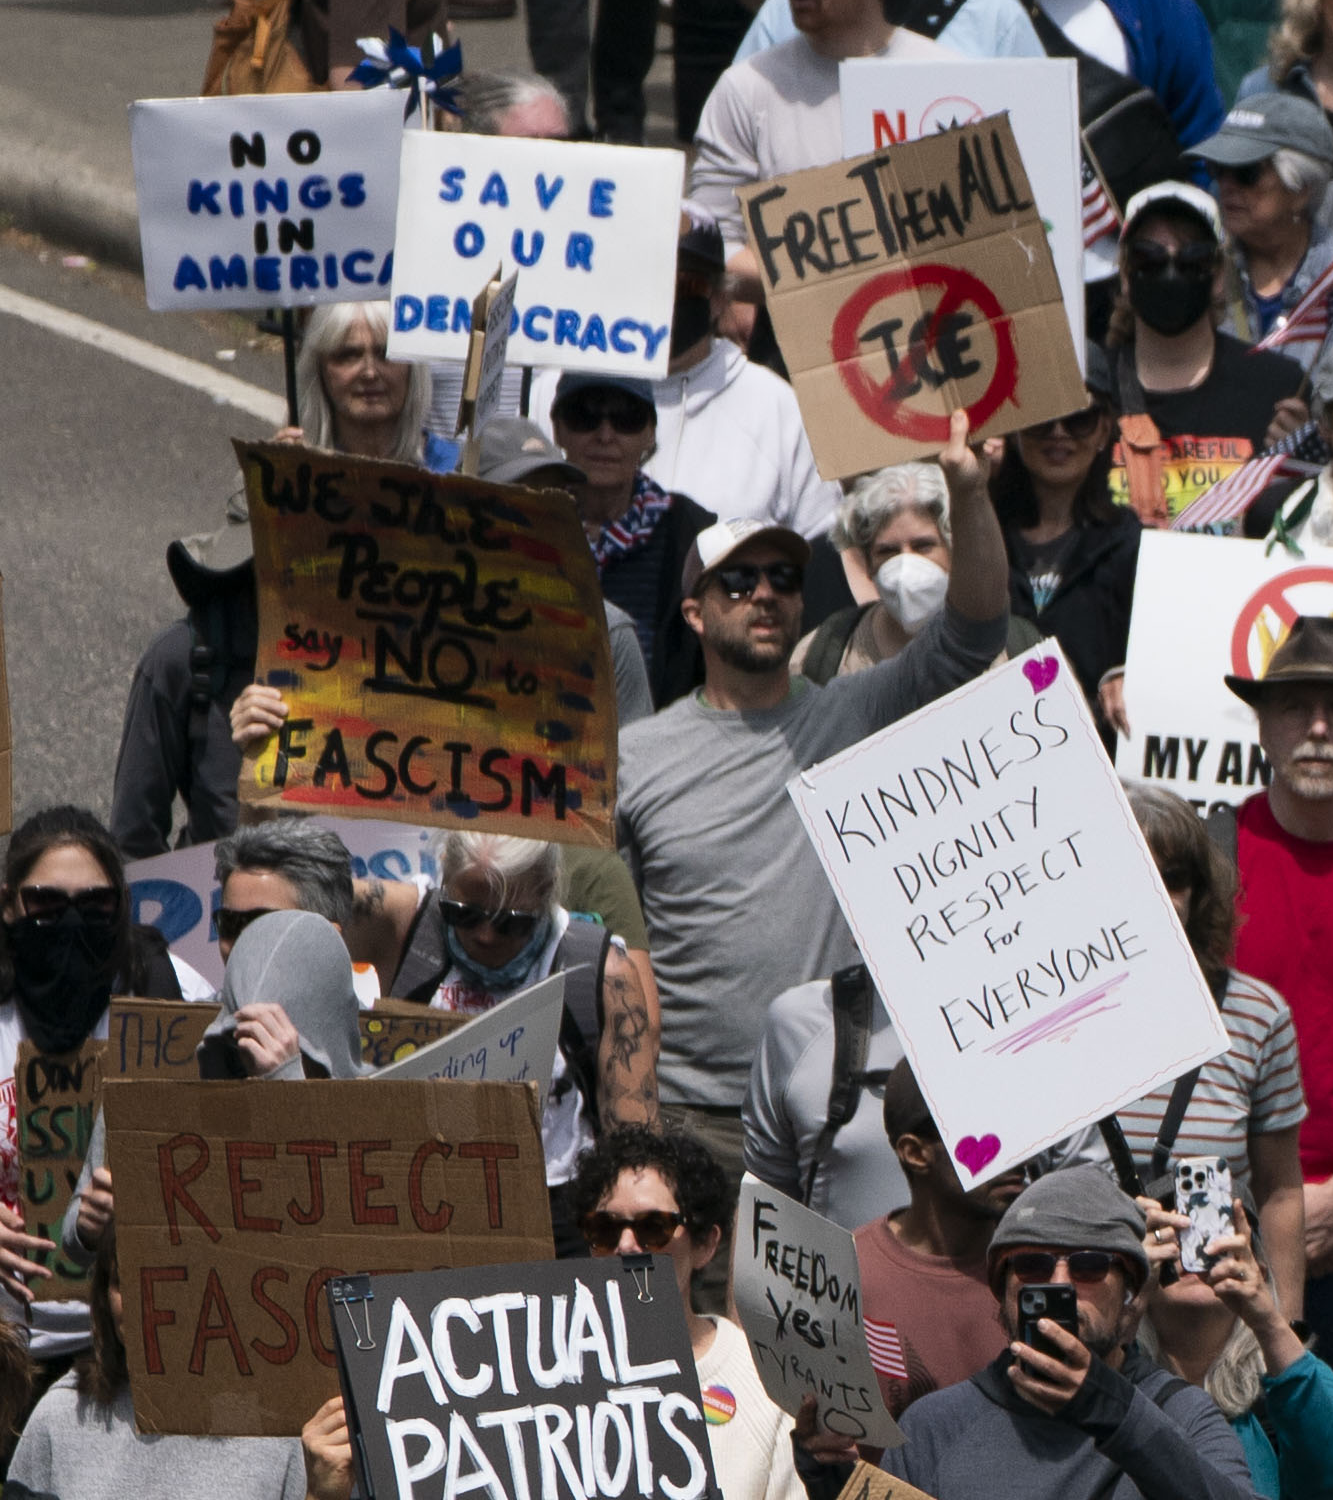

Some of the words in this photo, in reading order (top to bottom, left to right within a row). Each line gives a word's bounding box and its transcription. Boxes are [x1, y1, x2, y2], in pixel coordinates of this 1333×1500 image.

[230, 129, 322, 170] NO
[187, 172, 366, 219] KINGS
[438, 167, 618, 219] SAVE
[255, 217, 315, 255] IN
[453, 221, 596, 274] OUR
[284, 623, 344, 671] say
[364, 627, 478, 696] NO
[504, 655, 541, 696] to
[156, 1131, 520, 1248] REJECT
[377, 1278, 681, 1413] ACTUAL
